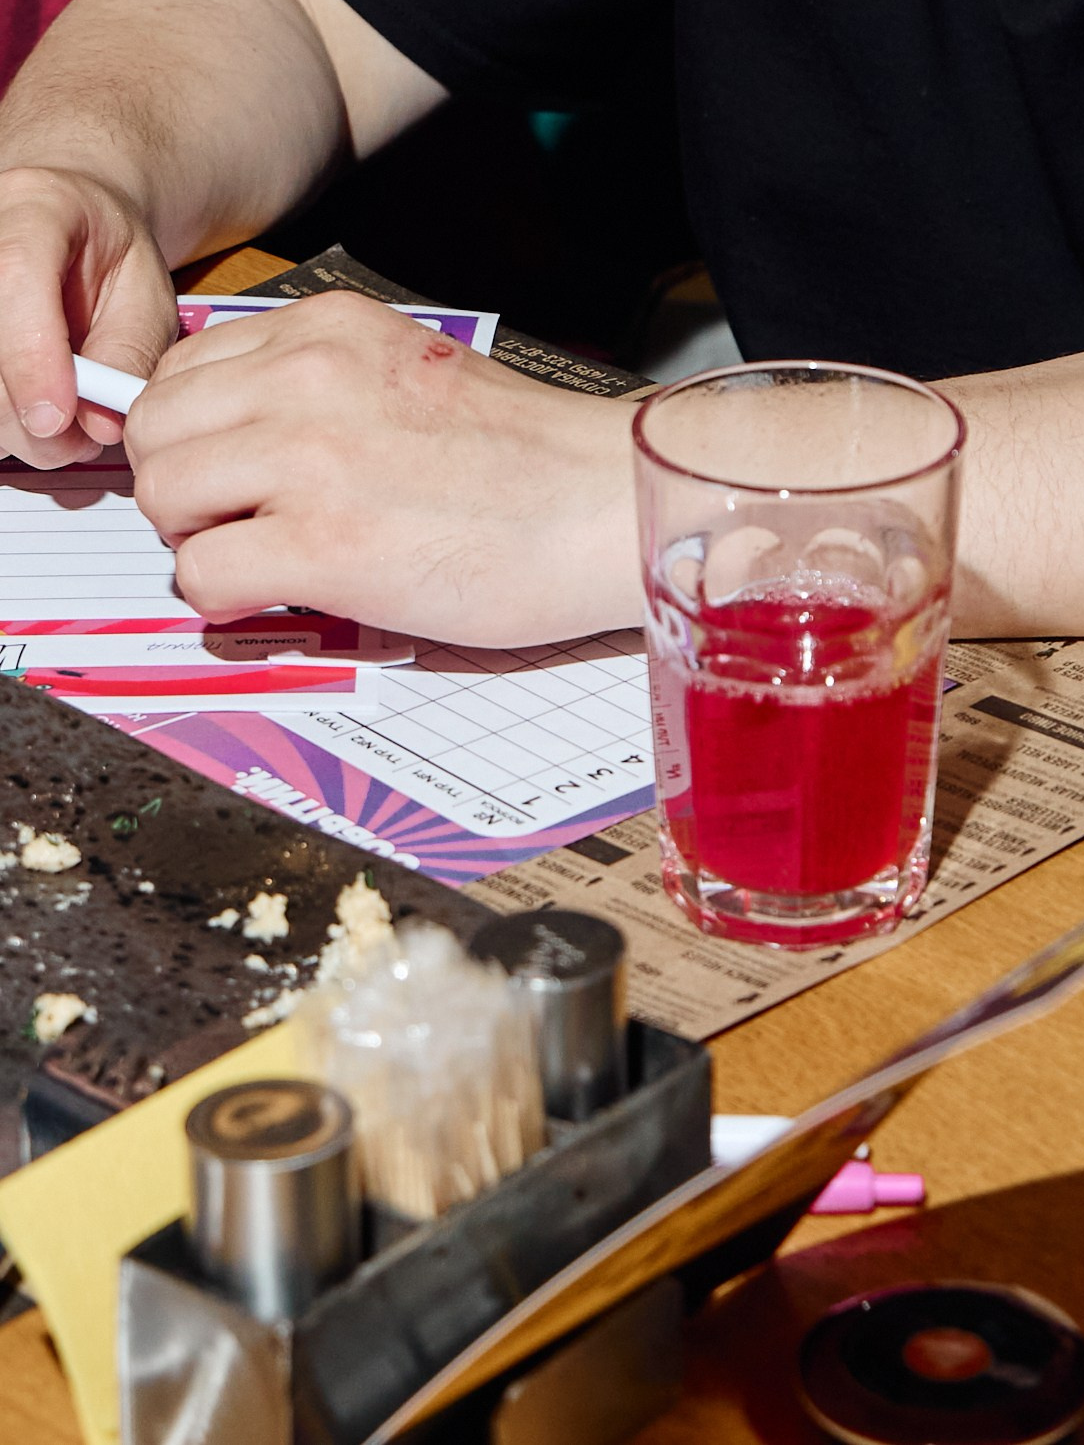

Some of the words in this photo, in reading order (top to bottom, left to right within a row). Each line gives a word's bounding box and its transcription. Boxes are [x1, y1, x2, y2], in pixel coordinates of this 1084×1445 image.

[500, 339, 568, 367] 323-87-77
[569, 362, 607, 381] (495)
[552, 369, 611, 396] СЛУЖБА
[234, 638, 307, 646] КОМАНДА
[316, 717, 344, 732] ТУР
[350, 735, 377, 751] №2
[374, 750, 402, 765] ТУР
[620, 755, 644, 763] 4
[412, 769, 438, 784] №1
[586, 767, 614, 781] 3
[434, 782, 464, 799] ТУР
[554, 781, 581, 793] 2
[522, 795, 542, 805] 1
[473, 811, 503, 826] №
